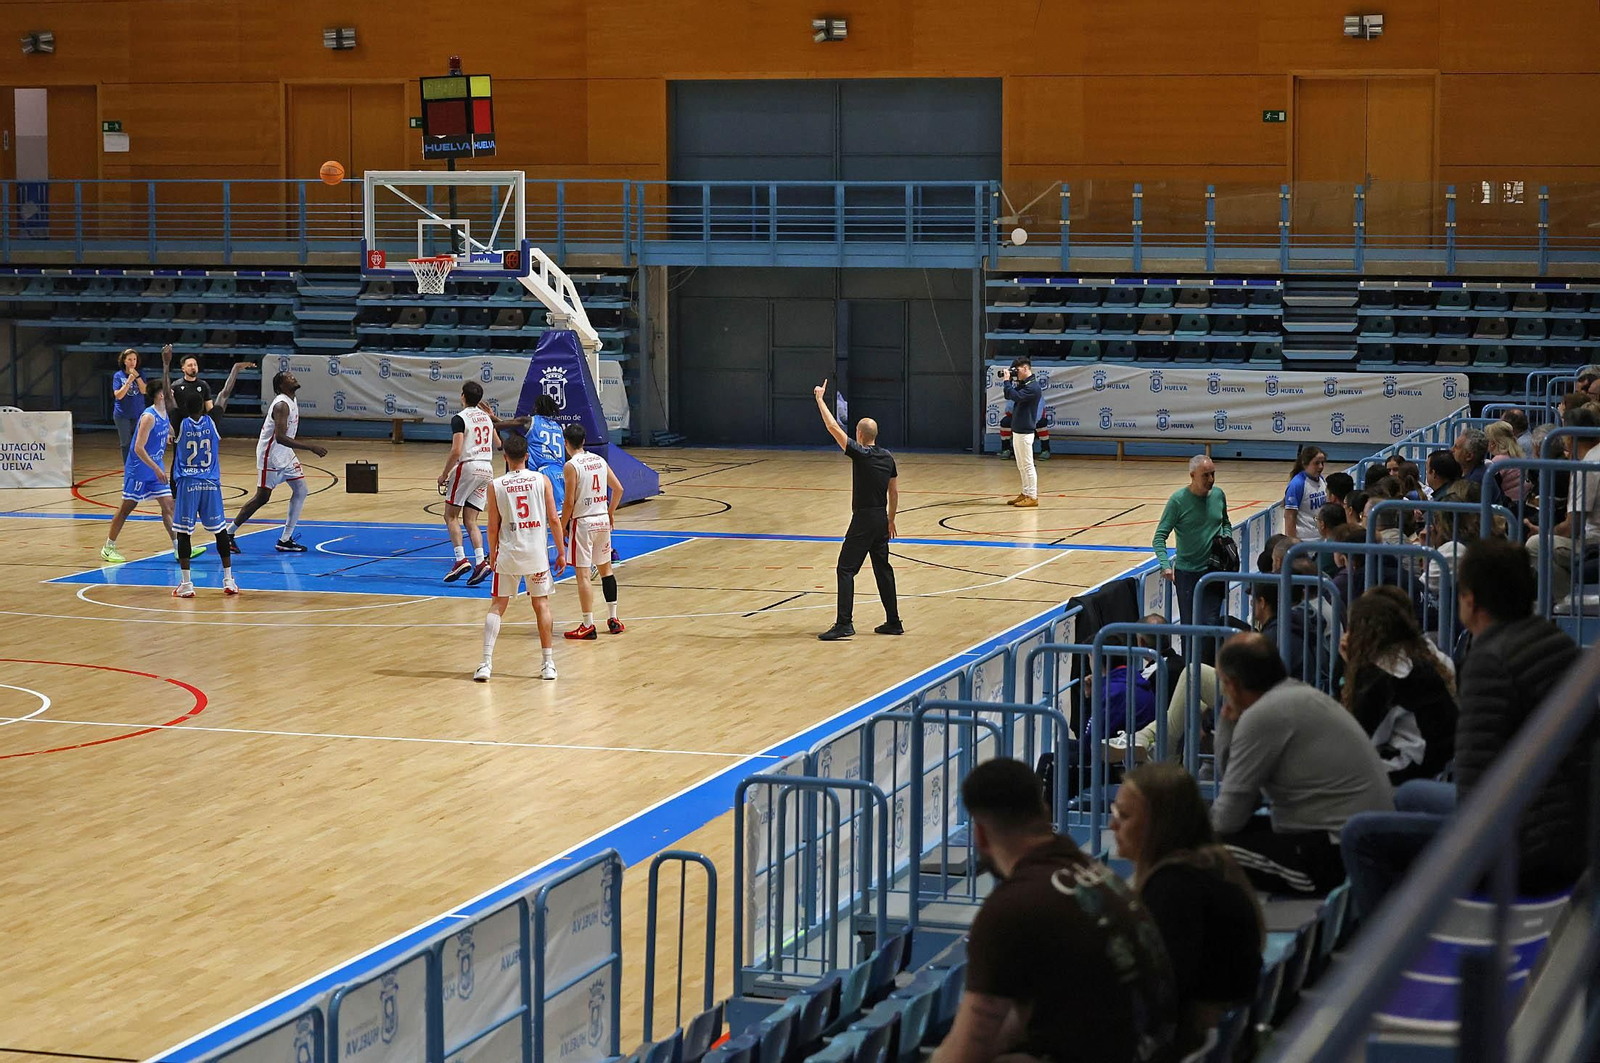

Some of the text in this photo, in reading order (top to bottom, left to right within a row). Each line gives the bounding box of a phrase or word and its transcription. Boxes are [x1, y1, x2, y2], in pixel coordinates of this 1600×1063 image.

[425, 142, 471, 152] HUELVA
[474, 140, 495, 150] HUELVA
[474, 426, 490, 446] 33
[540, 430, 562, 458] 25
[186, 438, 212, 468] 23
[506, 484, 533, 494] GREELEY
[592, 474, 600, 492] 4
[516, 496, 530, 519] 5
[518, 520, 541, 530] IXMA
